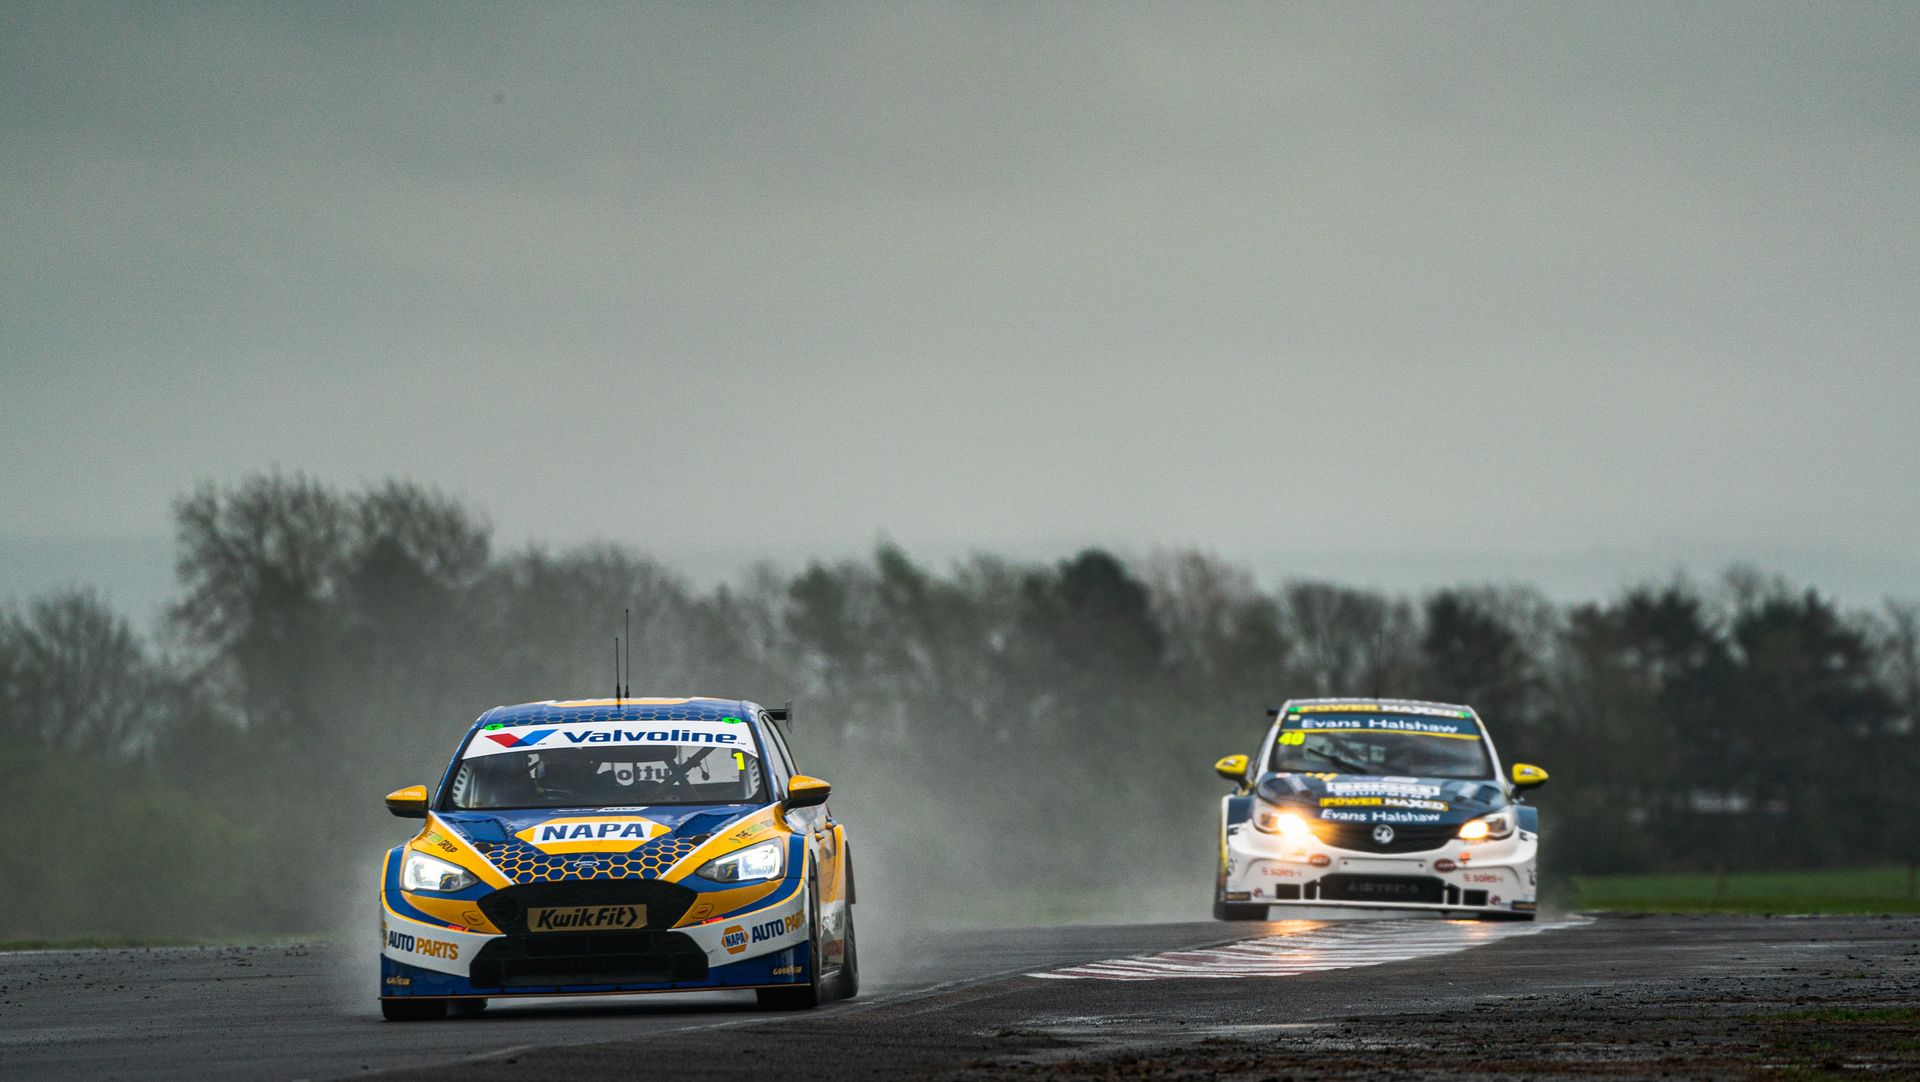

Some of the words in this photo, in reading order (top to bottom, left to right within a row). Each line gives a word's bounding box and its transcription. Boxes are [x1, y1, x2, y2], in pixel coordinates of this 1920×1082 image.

[1301, 718, 1361, 729] Evans
[1368, 719, 1458, 733] Halshaw
[563, 729, 738, 745] Valvoline
[732, 752, 746, 771] 1
[1321, 797, 1383, 808] POWER
[1384, 799, 1446, 811] MAXED
[1320, 808, 1367, 821] Evans
[1372, 811, 1440, 823] Halshaw
[541, 823, 645, 841] NAPA
[724, 931, 746, 947] NAPA
[751, 919, 785, 943] AUTO
[387, 930, 415, 953] AUTO
[415, 936, 459, 961] PARTS
